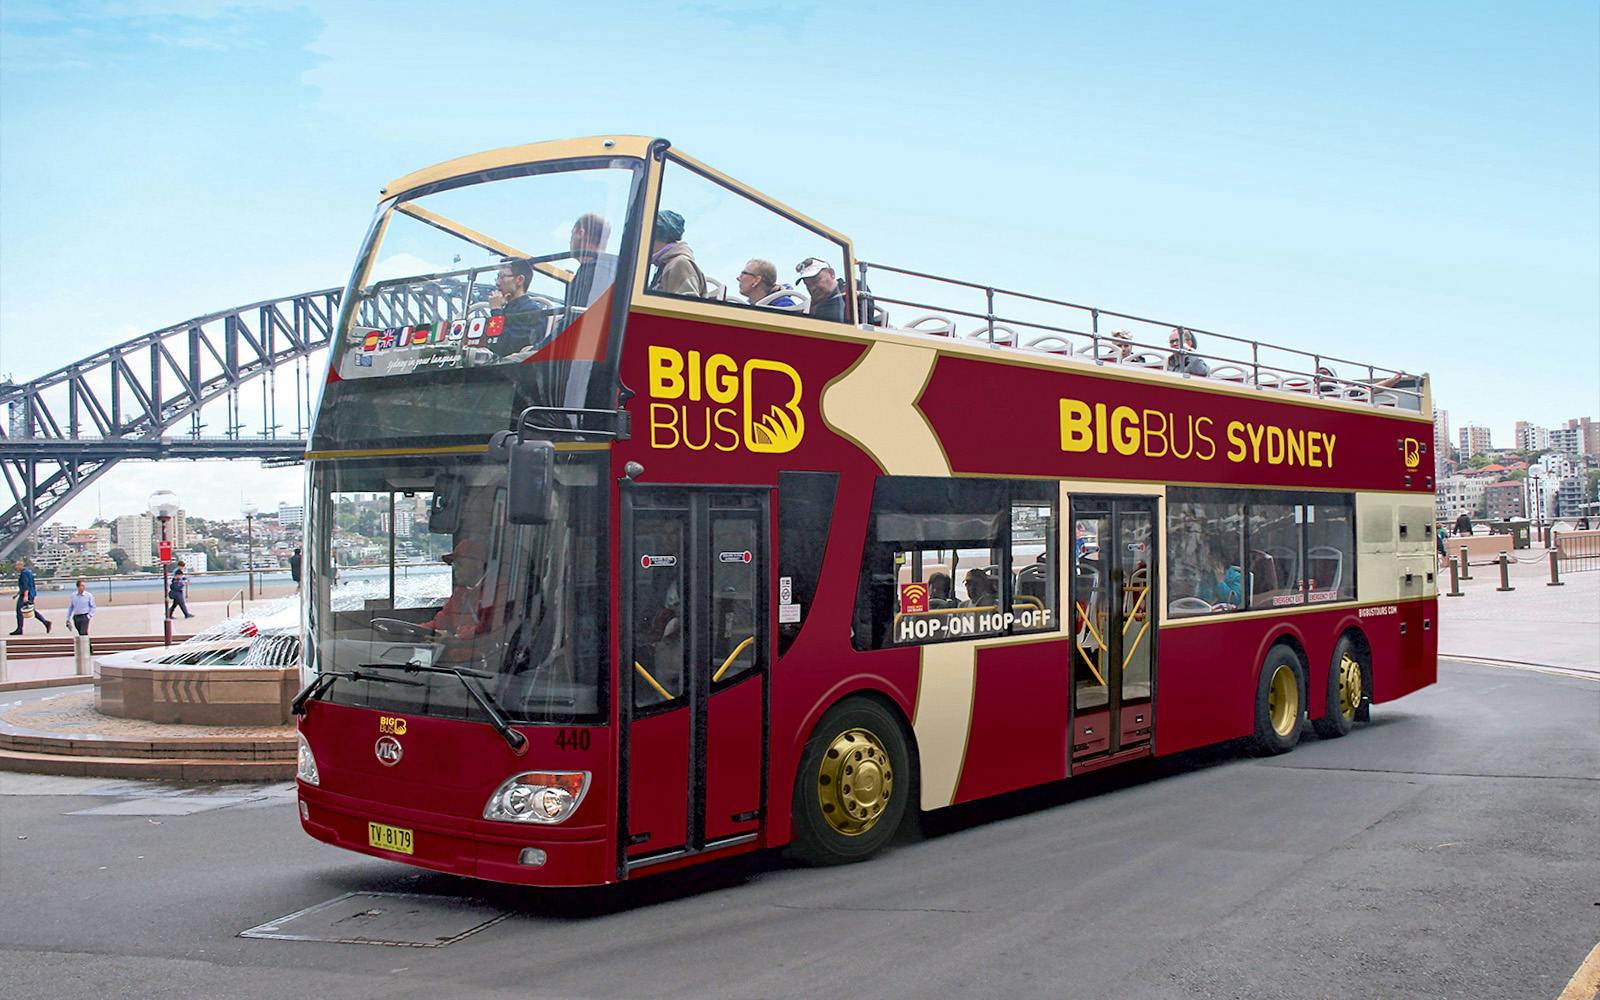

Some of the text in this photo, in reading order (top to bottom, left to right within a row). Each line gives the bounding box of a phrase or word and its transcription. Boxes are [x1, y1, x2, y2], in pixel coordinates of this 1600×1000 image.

[648, 345, 739, 404] BIG
[650, 402, 740, 452] BUS
[1226, 420, 1337, 469] SYDNEY
[900, 609, 1051, 640] HOP-ON HOP-OFF
[380, 716, 394, 725] BIG
[380, 724, 395, 734] BUS
[555, 729, 591, 751] 440
